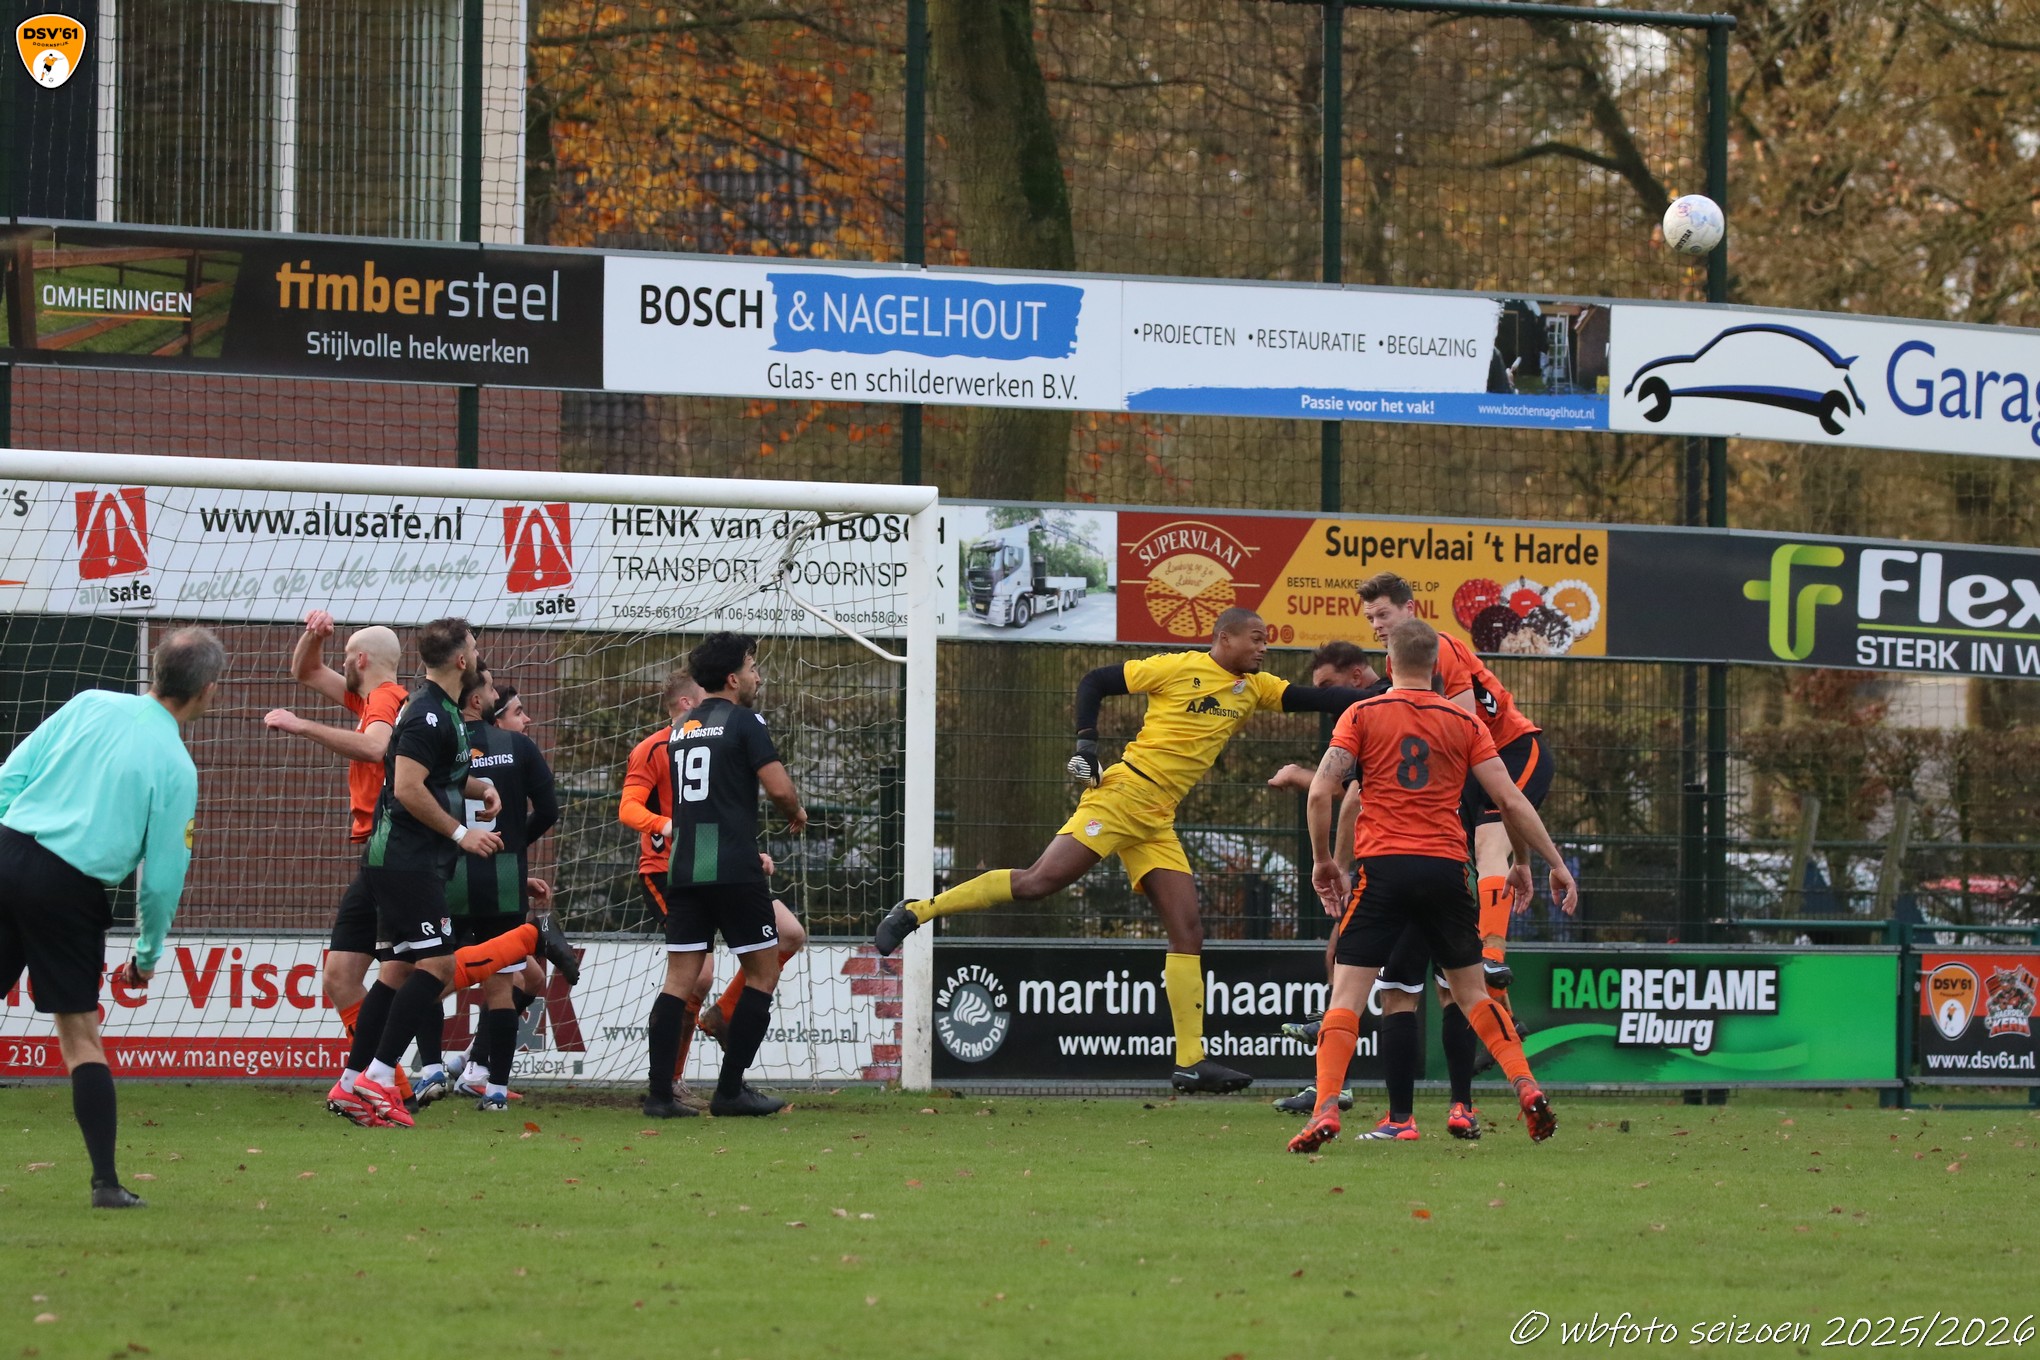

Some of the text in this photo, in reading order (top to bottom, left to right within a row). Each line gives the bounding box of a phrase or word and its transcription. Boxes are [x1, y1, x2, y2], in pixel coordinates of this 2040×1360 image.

[43, 284, 192, 313] OMHEININGEN
[276, 260, 559, 322] timbersteel
[640, 285, 1047, 341] BOSCH & NAGELHOUT
[307, 331, 529, 364] Stijlvolle hekwerken
[768, 363, 1078, 400] Glas- en schilderwerken B.V.
[1887, 340, 2040, 447] Gara
[1301, 394, 1435, 414] Passie voor het vak!
[1478, 404, 1595, 420] www.boschennagelhout.nl
[200, 501, 462, 540] www.alusafe.nl
[612, 507, 700, 538] HENK
[711, 516, 761, 540] van
[1139, 529, 1242, 569] SUPERVLAAI
[1325, 525, 1599, 566] Supervlaai 't Harde
[179, 552, 481, 609] veilig op elke hoogte
[613, 556, 762, 584] TRANSPORT
[1287, 577, 1321, 588] BESTEL
[1425, 581, 1440, 592] OP
[79, 581, 152, 605] alusafe
[506, 594, 576, 618] alusafe
[1857, 635, 1960, 671] STERK
[1971, 642, 2003, 673] IN
[1209, 707, 1240, 720] LOGISTICS
[686, 725, 724, 740] LOGISTICS
[674, 746, 711, 804] 19
[1396, 736, 1430, 790] 8
[936, 965, 1008, 1008] MARTIN'S
[1019, 970, 1166, 1015] martin'
[1934, 978, 1971, 990] DSV'61
[938, 1016, 1007, 1057] HAARMODE
[1618, 1012, 1713, 1051] Elburg
[9, 1045, 46, 1066] 230
[1927, 1051, 2036, 1070] www.dsv61.nl
